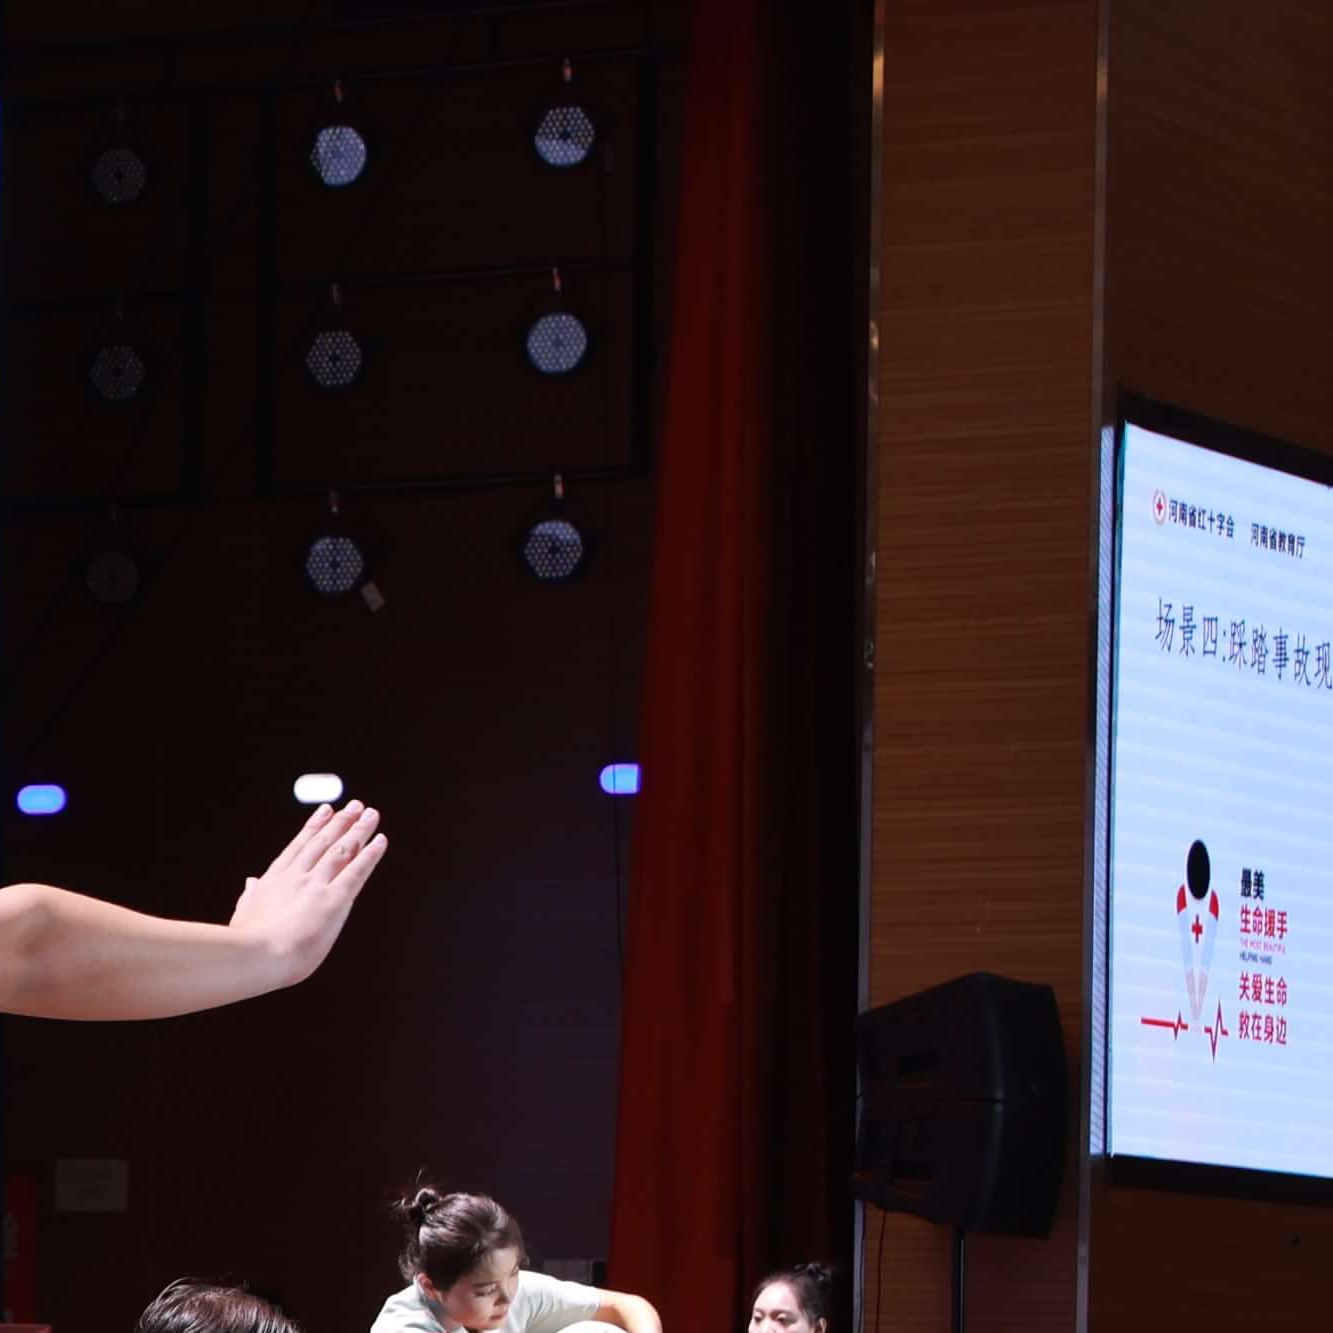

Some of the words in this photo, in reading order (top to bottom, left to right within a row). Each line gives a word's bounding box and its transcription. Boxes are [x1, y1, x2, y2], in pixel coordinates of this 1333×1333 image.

[1168, 499, 1234, 538] 河南省红十字会
[1250, 521, 1306, 559] 河南省教育厅
[1240, 867, 1265, 900] 最美
[1239, 903, 1288, 940] 生命援手
[1239, 971, 1288, 1008] 关爱生命
[1238, 1010, 1287, 1046] 救在身边
